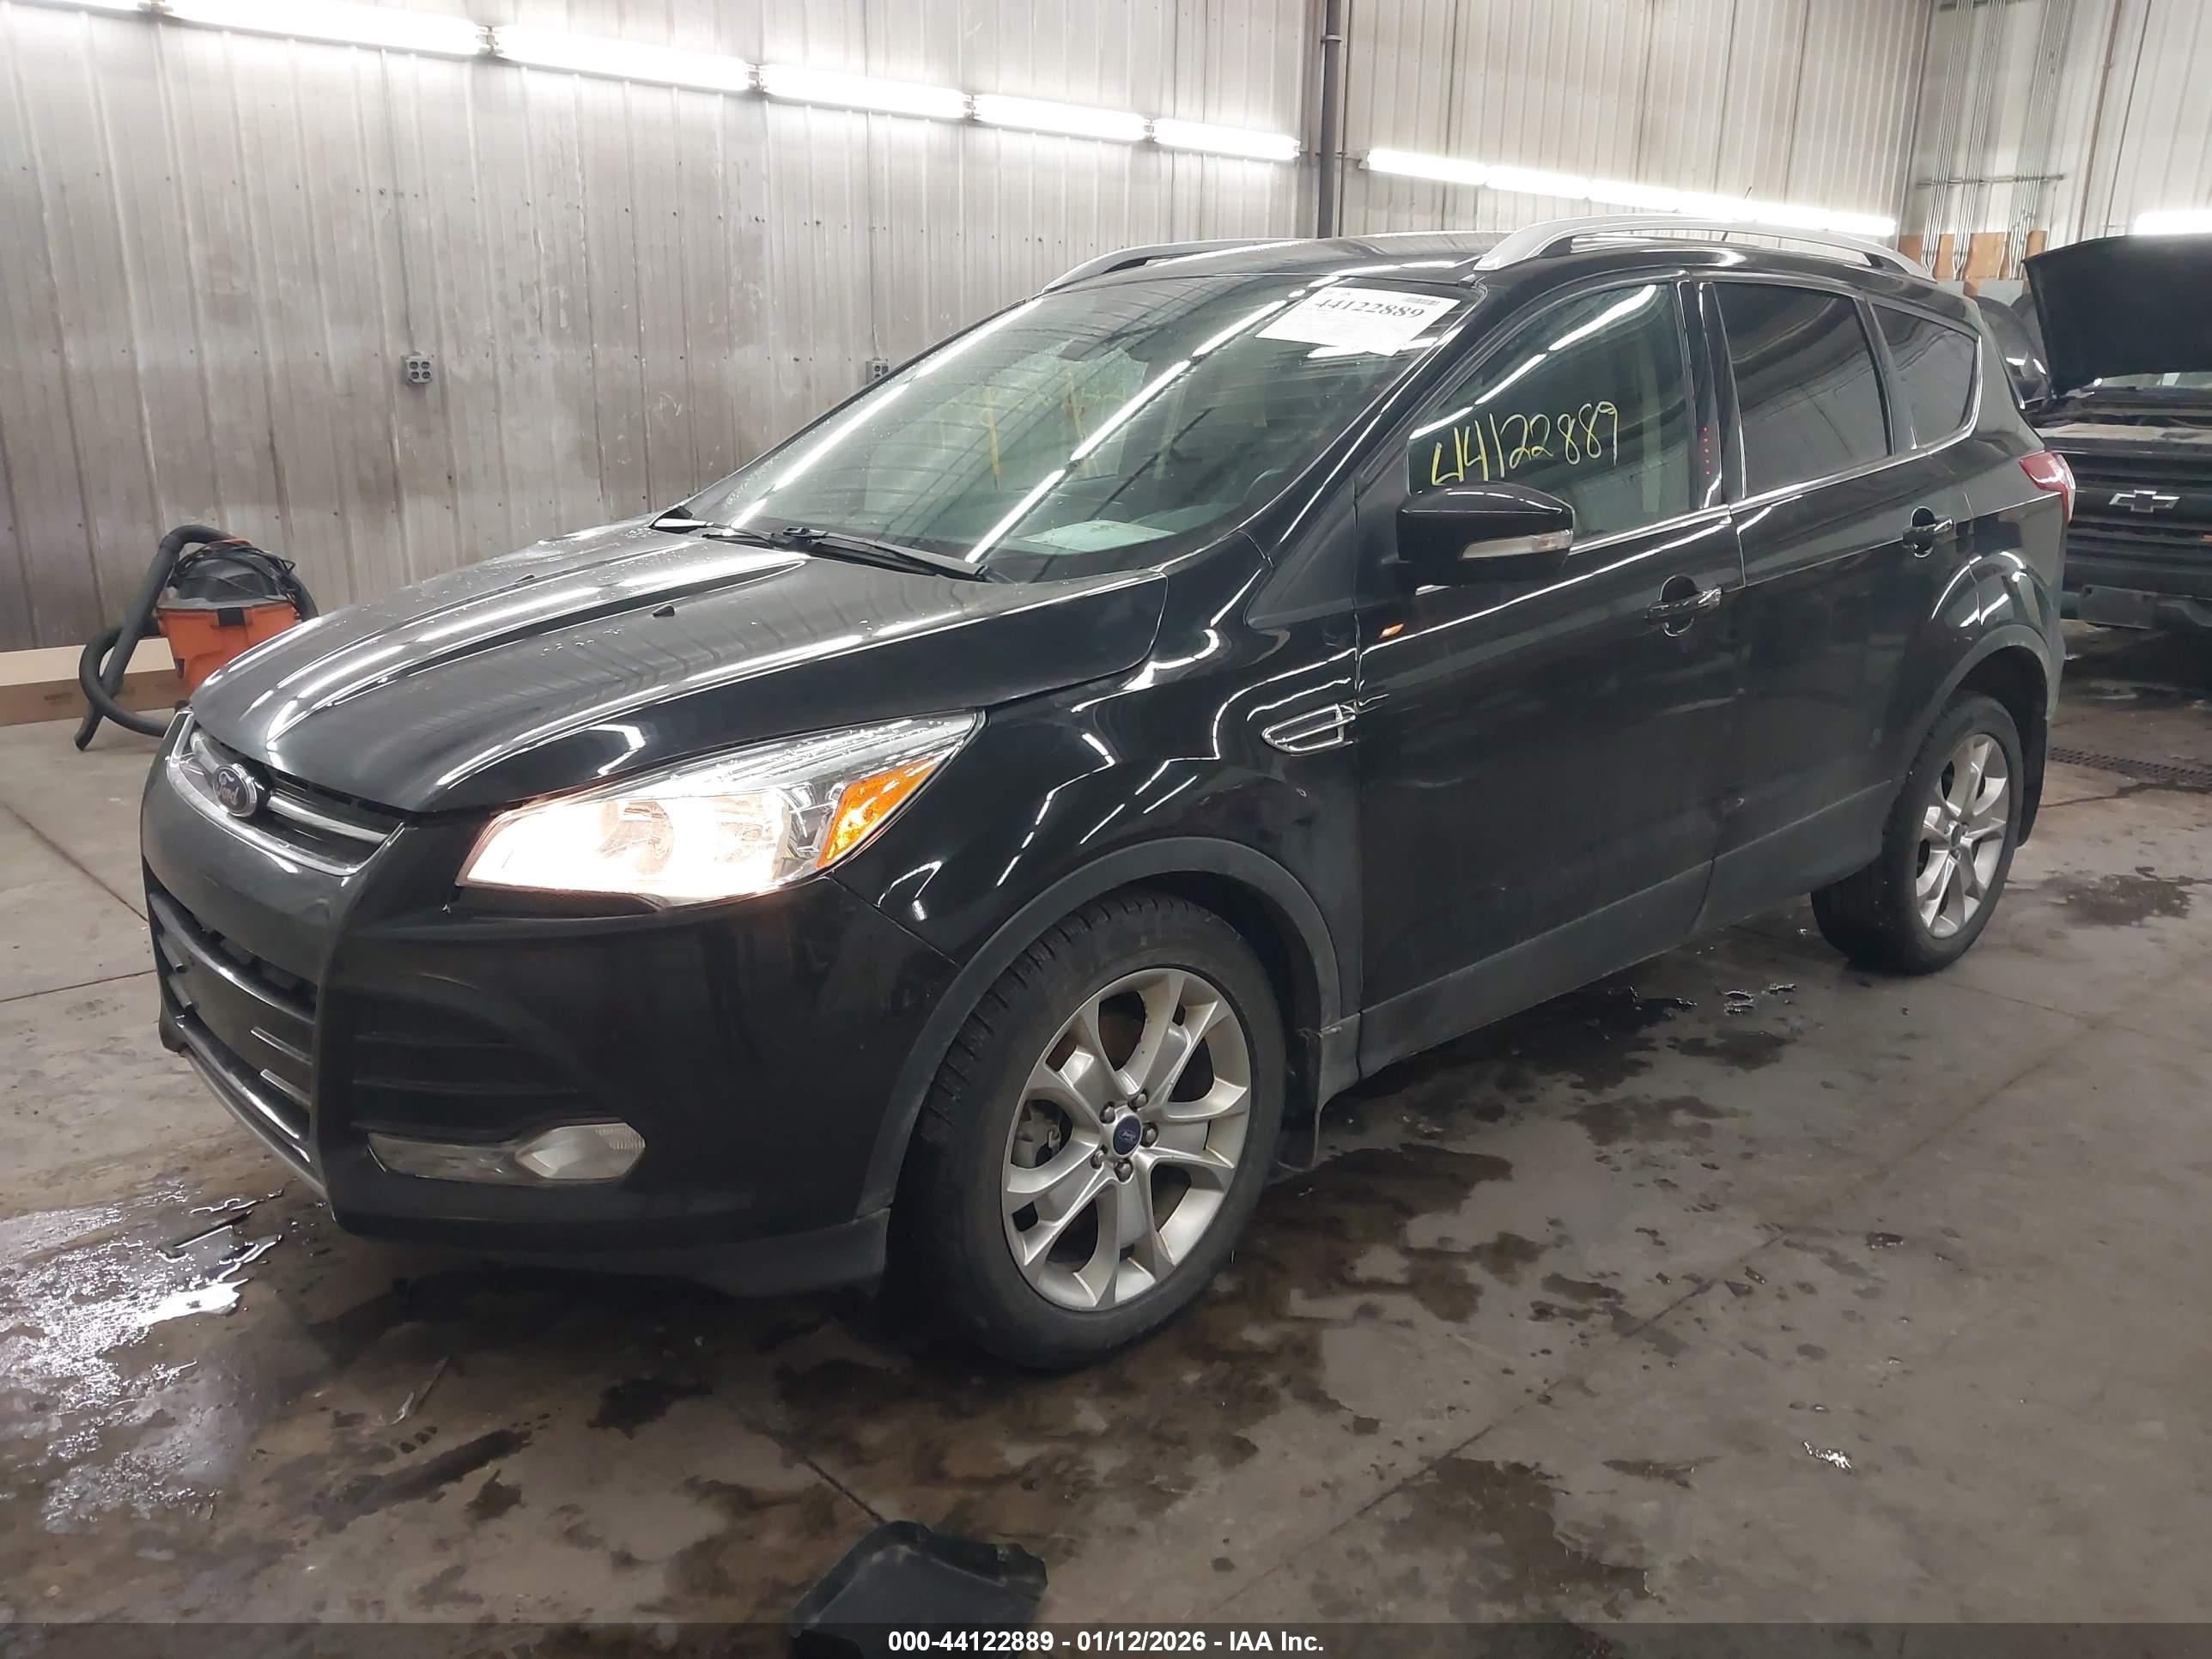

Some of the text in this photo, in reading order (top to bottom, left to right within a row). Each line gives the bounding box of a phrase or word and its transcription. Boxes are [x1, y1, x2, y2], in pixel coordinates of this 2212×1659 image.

[1313, 298, 1425, 319] 44122889
[1431, 401, 1618, 485] 44122889
[217, 771, 240, 805] Ford
